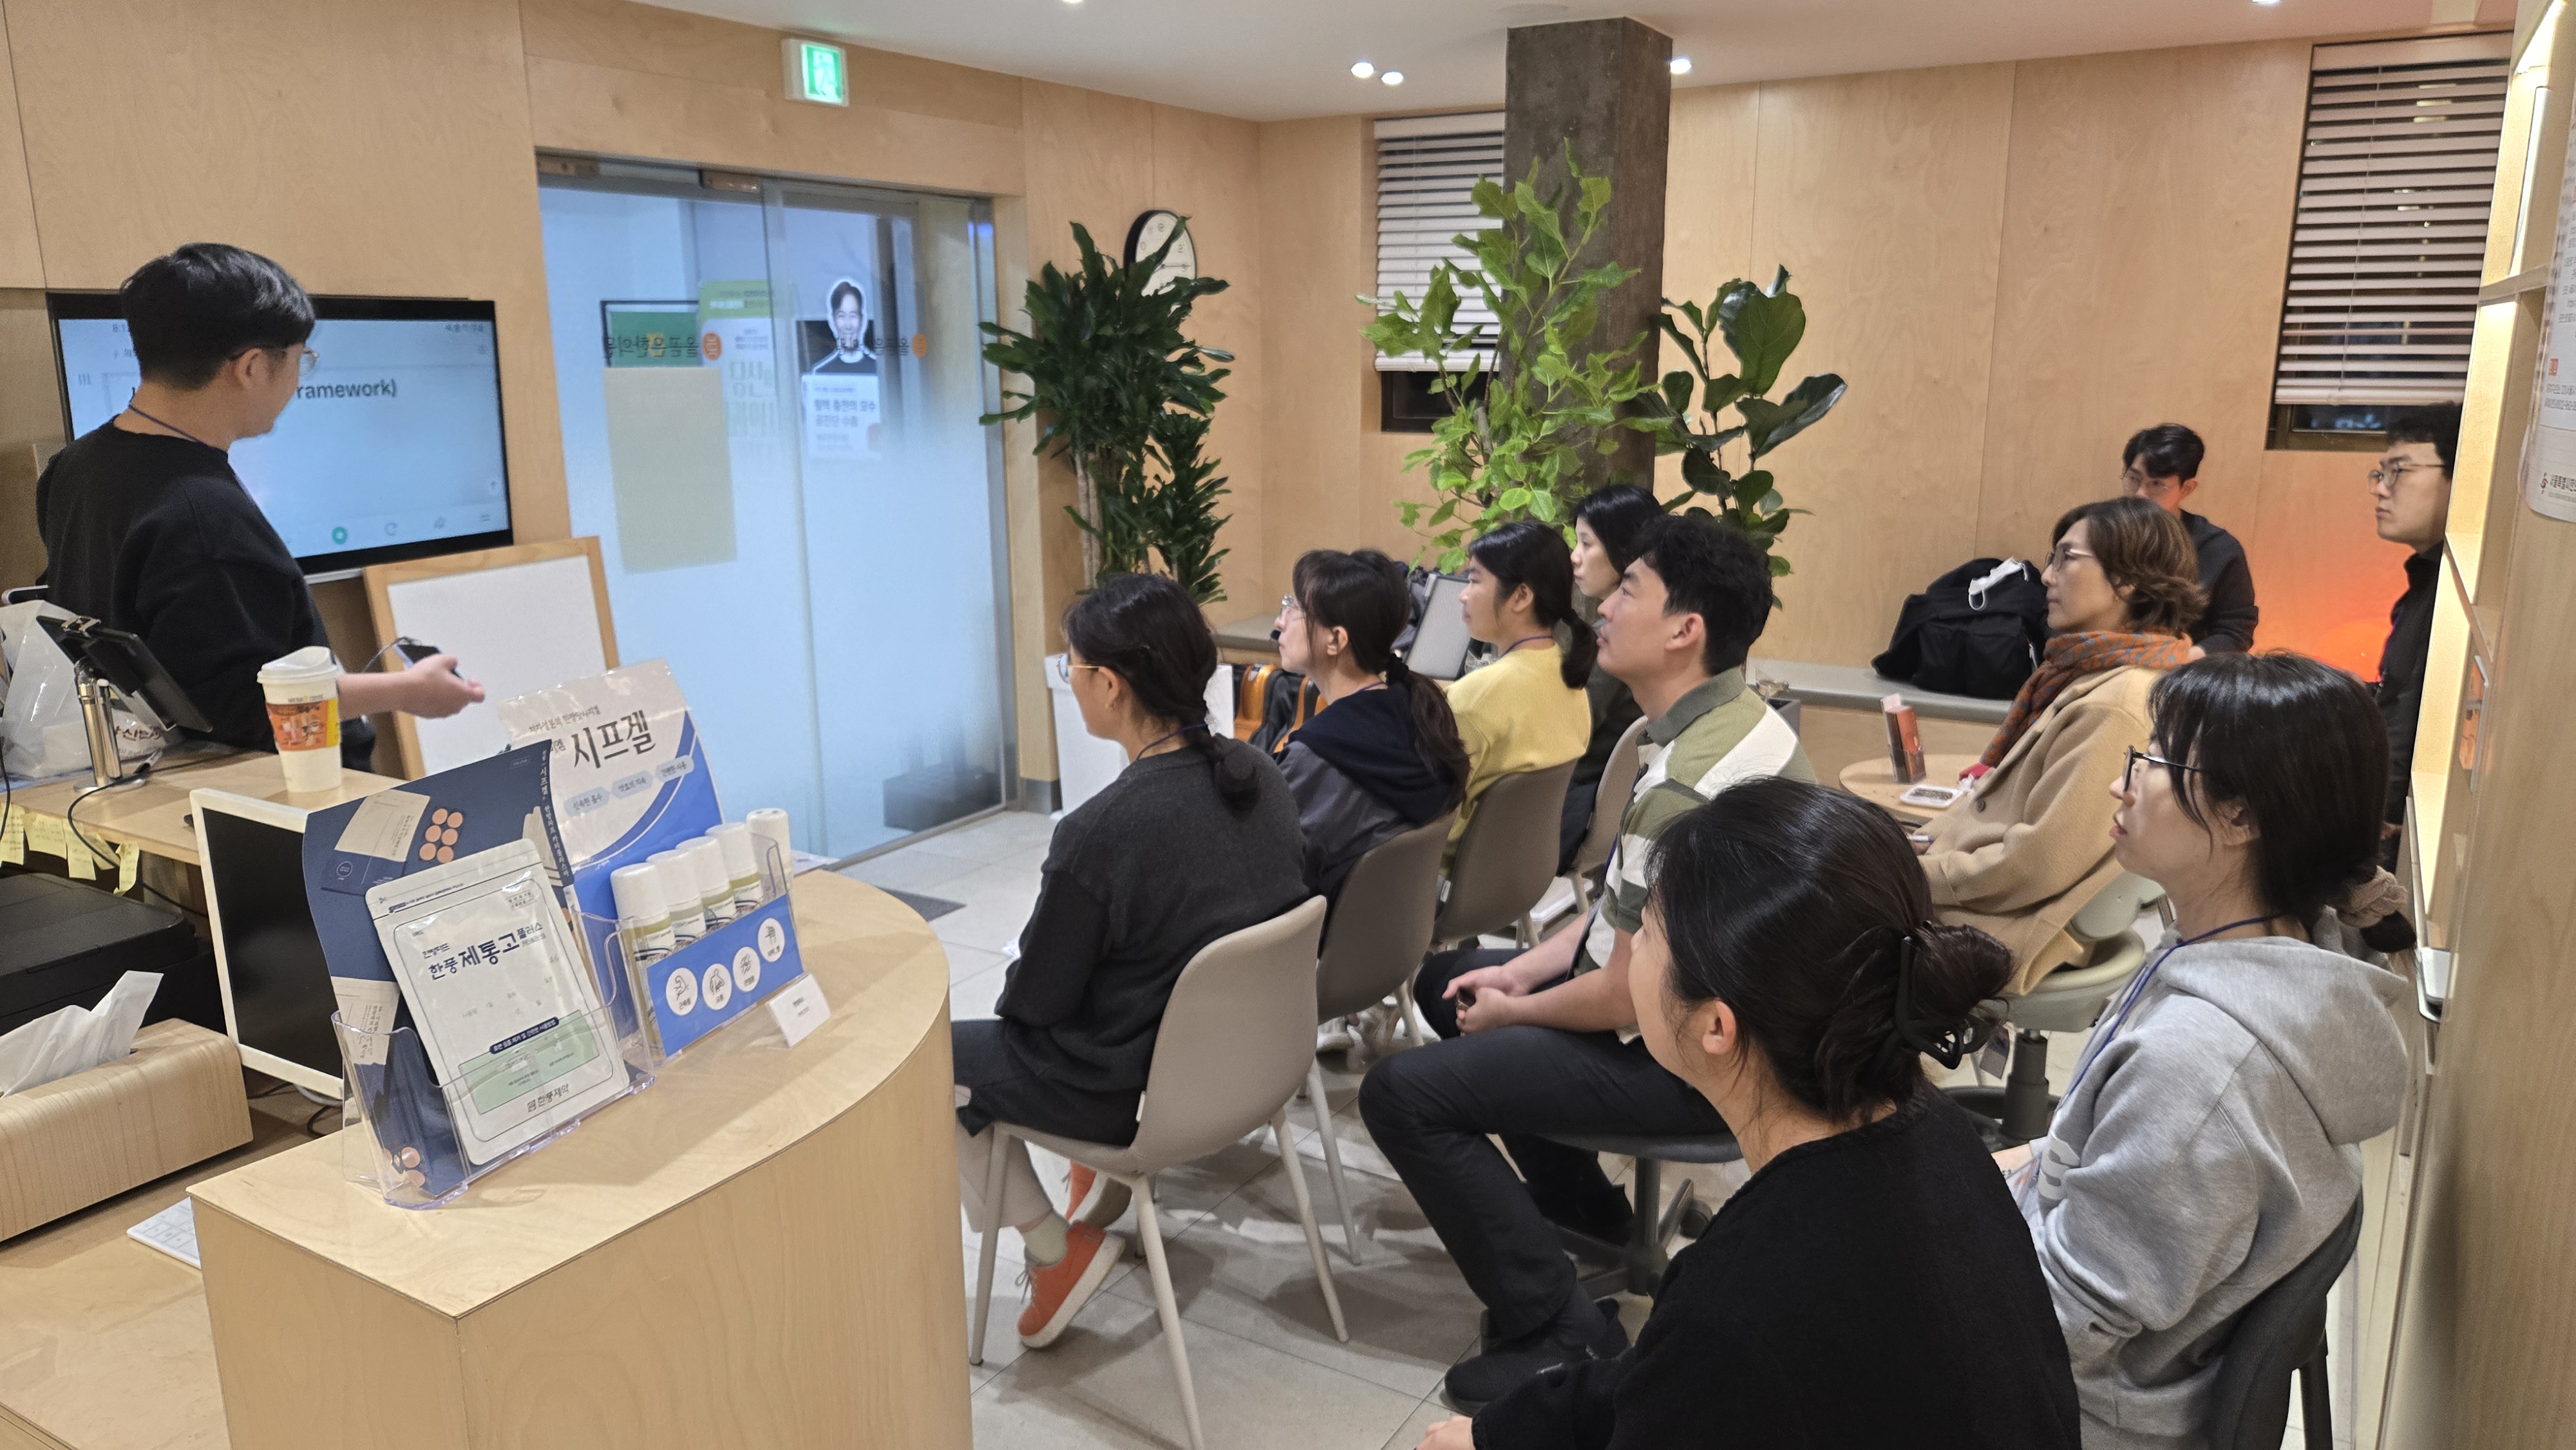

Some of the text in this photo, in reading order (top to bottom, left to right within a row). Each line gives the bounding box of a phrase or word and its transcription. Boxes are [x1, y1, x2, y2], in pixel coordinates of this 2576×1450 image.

[296, 379, 397, 399] ramework)
[571, 709, 657, 769] 시프겔
[428, 921, 544, 981] 한풍 제통고 플러스
[537, 1083, 569, 1107] 한풍제약
